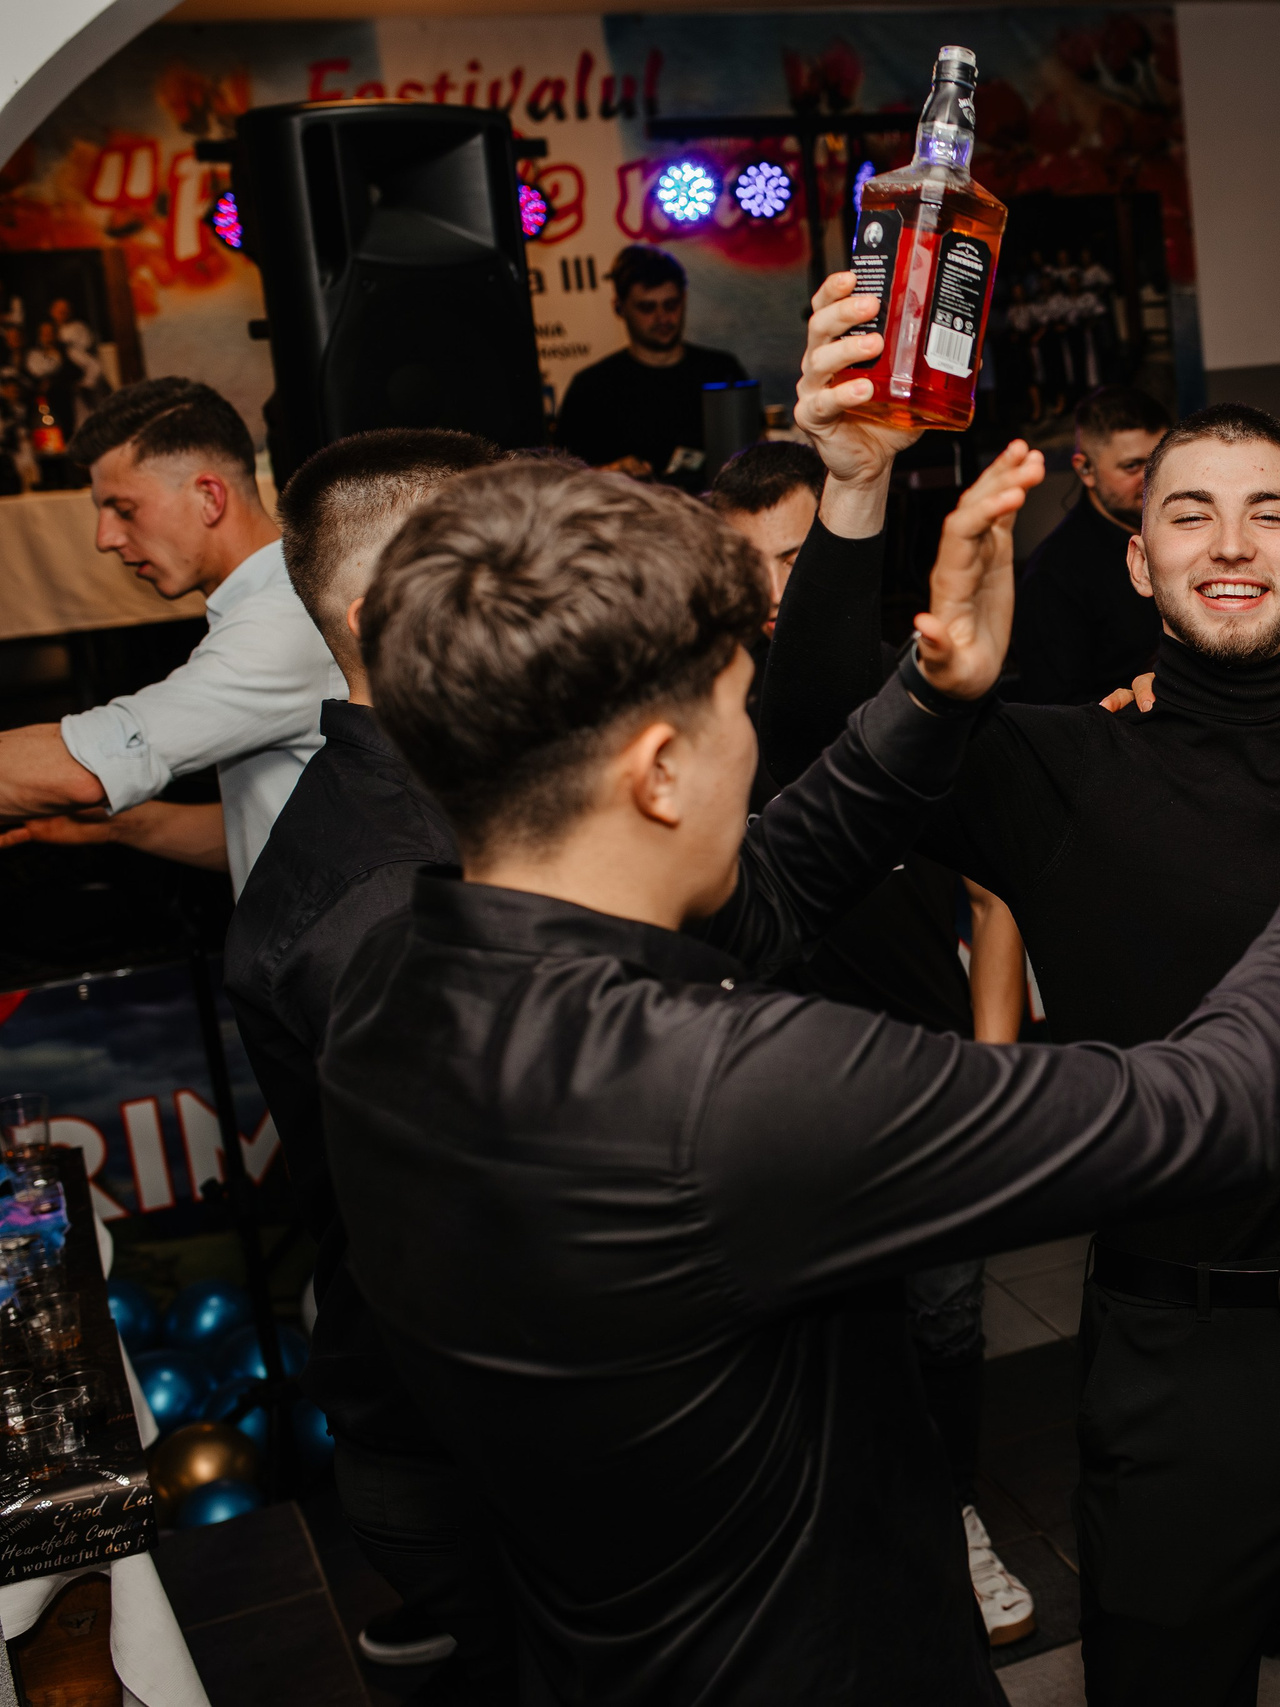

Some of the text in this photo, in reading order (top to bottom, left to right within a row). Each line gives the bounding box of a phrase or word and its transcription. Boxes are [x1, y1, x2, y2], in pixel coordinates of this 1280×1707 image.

[53, 1494, 109, 1533] Good
[1, 1530, 79, 1561] Heartfelt
[22, 1545, 100, 1574] wonderful
[104, 1540, 132, 1555] day
